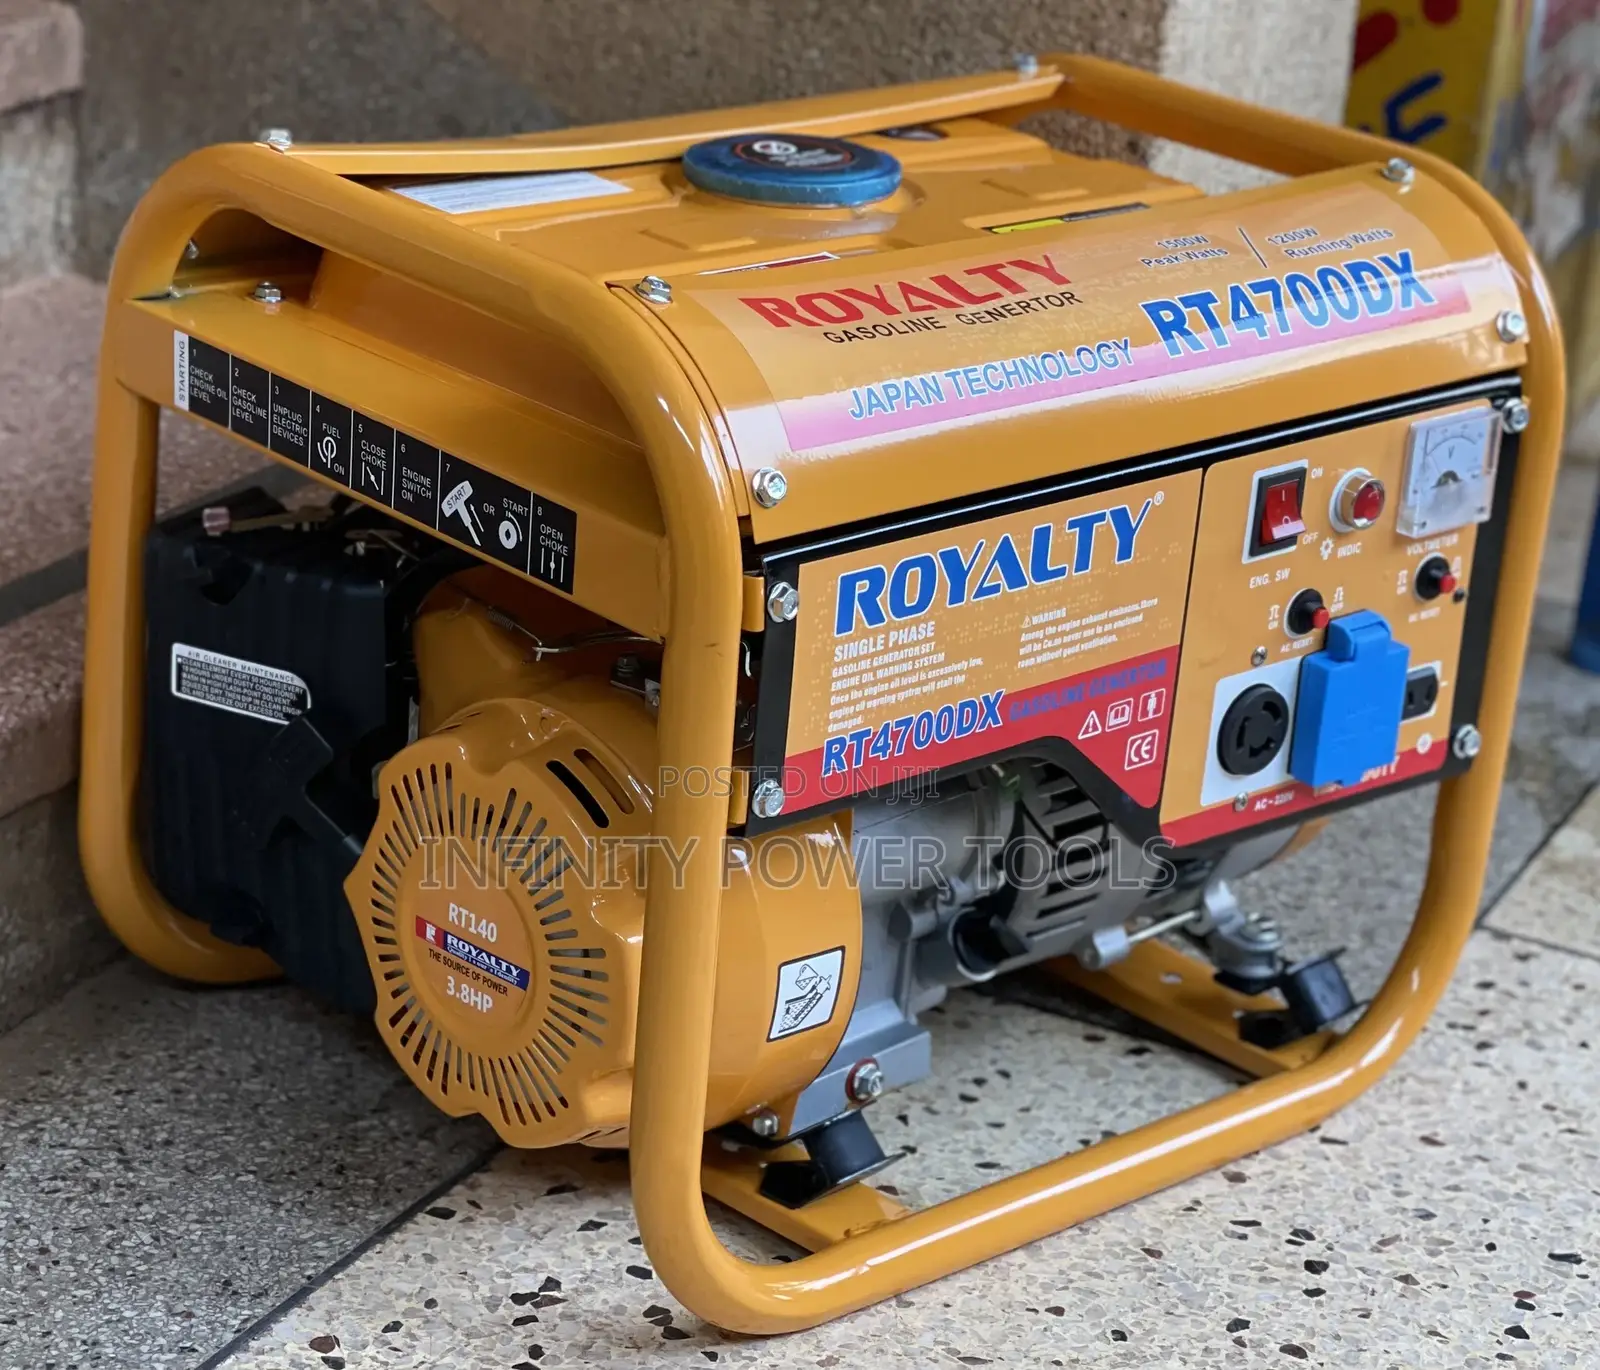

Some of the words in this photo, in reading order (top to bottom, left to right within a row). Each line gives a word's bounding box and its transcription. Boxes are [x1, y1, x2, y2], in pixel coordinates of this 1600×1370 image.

[1156, 234, 1209, 250] 1500W
[1266, 227, 1319, 246] 1200W
[1284, 238, 1351, 259] Running
[1352, 228, 1394, 245] Watts
[1141, 250, 1181, 268] Peak
[1185, 246, 1229, 262] Watts
[738, 254, 1072, 328] ROYALTY
[1140, 250, 1438, 359] RT4700DX
[823, 316, 947, 344] GASOLINE
[954, 291, 1084, 325] GENERTOR
[178, 340, 186, 402] STARTING
[189, 365, 213, 382] CHECK
[234, 367, 240, 377] 2
[849, 373, 947, 420] JAPAN
[944, 337, 1134, 400] TECHNOLOGY
[190, 377, 216, 395] ENGINE
[216, 388, 228, 401] OIL
[190, 387, 211, 404] LEVEL
[232, 385, 257, 403] CHECK
[274, 385, 280, 395] 3
[232, 396, 268, 420] GASOLINE
[232, 407, 254, 424] LEVEL
[273, 403, 303, 424] UNPLUG
[315, 404, 321, 414] 4
[272, 414, 308, 437] ELECTRIC
[322, 423, 341, 440] FUEL
[358, 423, 363, 434] 5
[361, 440, 387, 459] CLOSE
[401, 443, 406, 453] 6
[333, 463, 345, 476] ON
[360, 451, 387, 471] CHOKE
[445, 463, 451, 473] 7
[402, 466, 432, 488] ENGINE
[1311, 466, 1324, 479] ON
[401, 478, 432, 499] SWITCH
[446, 485, 467, 510] START
[482, 502, 495, 516] OR
[502, 498, 529, 517] START
[537, 506, 543, 516] 8
[540, 523, 563, 542] OPEN
[1302, 531, 1319, 545] OFF
[539, 535, 569, 556] CHOKE
[1337, 542, 1363, 558] INDIC
[1407, 533, 1459, 556] VOLTMETER
[834, 499, 1152, 637] ROYALTY
[1275, 568, 1291, 582] SW
[1032, 607, 1067, 625] WARNING
[1045, 625, 1057, 636] the
[1057, 619, 1081, 632] engine
[834, 634, 885, 663] SINGLE
[888, 621, 936, 648] PHASE
[1019, 643, 1032, 656] will
[1033, 642, 1042, 652] be
[1082, 627, 1095, 638] use
[1096, 625, 1103, 634] in
[1104, 622, 1113, 632] an
[832, 658, 872, 678] GASOLINE
[872, 646, 921, 667] GENERATOR
[920, 641, 936, 656] SET
[1036, 648, 1063, 664] without
[1062, 643, 1081, 658] good
[182, 658, 200, 667] CLEAN
[202, 663, 229, 675] ELEMENT
[230, 671, 250, 680] EVERY
[260, 678, 281, 688] HOURS
[204, 655, 236, 668] CLEANER
[241, 665, 294, 683] MAINTENANCE
[831, 674, 861, 692] ENGINE
[861, 671, 875, 683] OIL
[876, 661, 913, 679] WARNING
[914, 652, 946, 669] SYSTEM
[233, 679, 254, 689] DUSTY
[830, 692, 849, 706] Once
[850, 688, 863, 700] the
[863, 684, 889, 699] engine
[890, 678, 900, 689] oil
[901, 674, 919, 687] level
[919, 671, 927, 681] is
[927, 660, 968, 678] excessively
[206, 693, 233, 705] SQUEEZE
[235, 701, 248, 709] OUT
[249, 705, 273, 716] EXCESS
[261, 700, 281, 710] CLEAN
[829, 704, 855, 720] engine
[855, 700, 865, 712] oil
[866, 692, 896, 709] warning
[922, 681, 936, 695] will
[936, 678, 953, 689] stall
[954, 674, 966, 684] the
[822, 689, 1006, 777] RT4700DX
[1009, 681, 1085, 722] GASOLINE
[448, 902, 497, 943] RT140
[446, 934, 521, 977] ROYALTY
[429, 948, 441, 962] THE
[443, 956, 470, 978] SOURCE
[471, 971, 481, 981] OF
[482, 976, 508, 997] POWER
[446, 975, 493, 1013] 3.8HP
